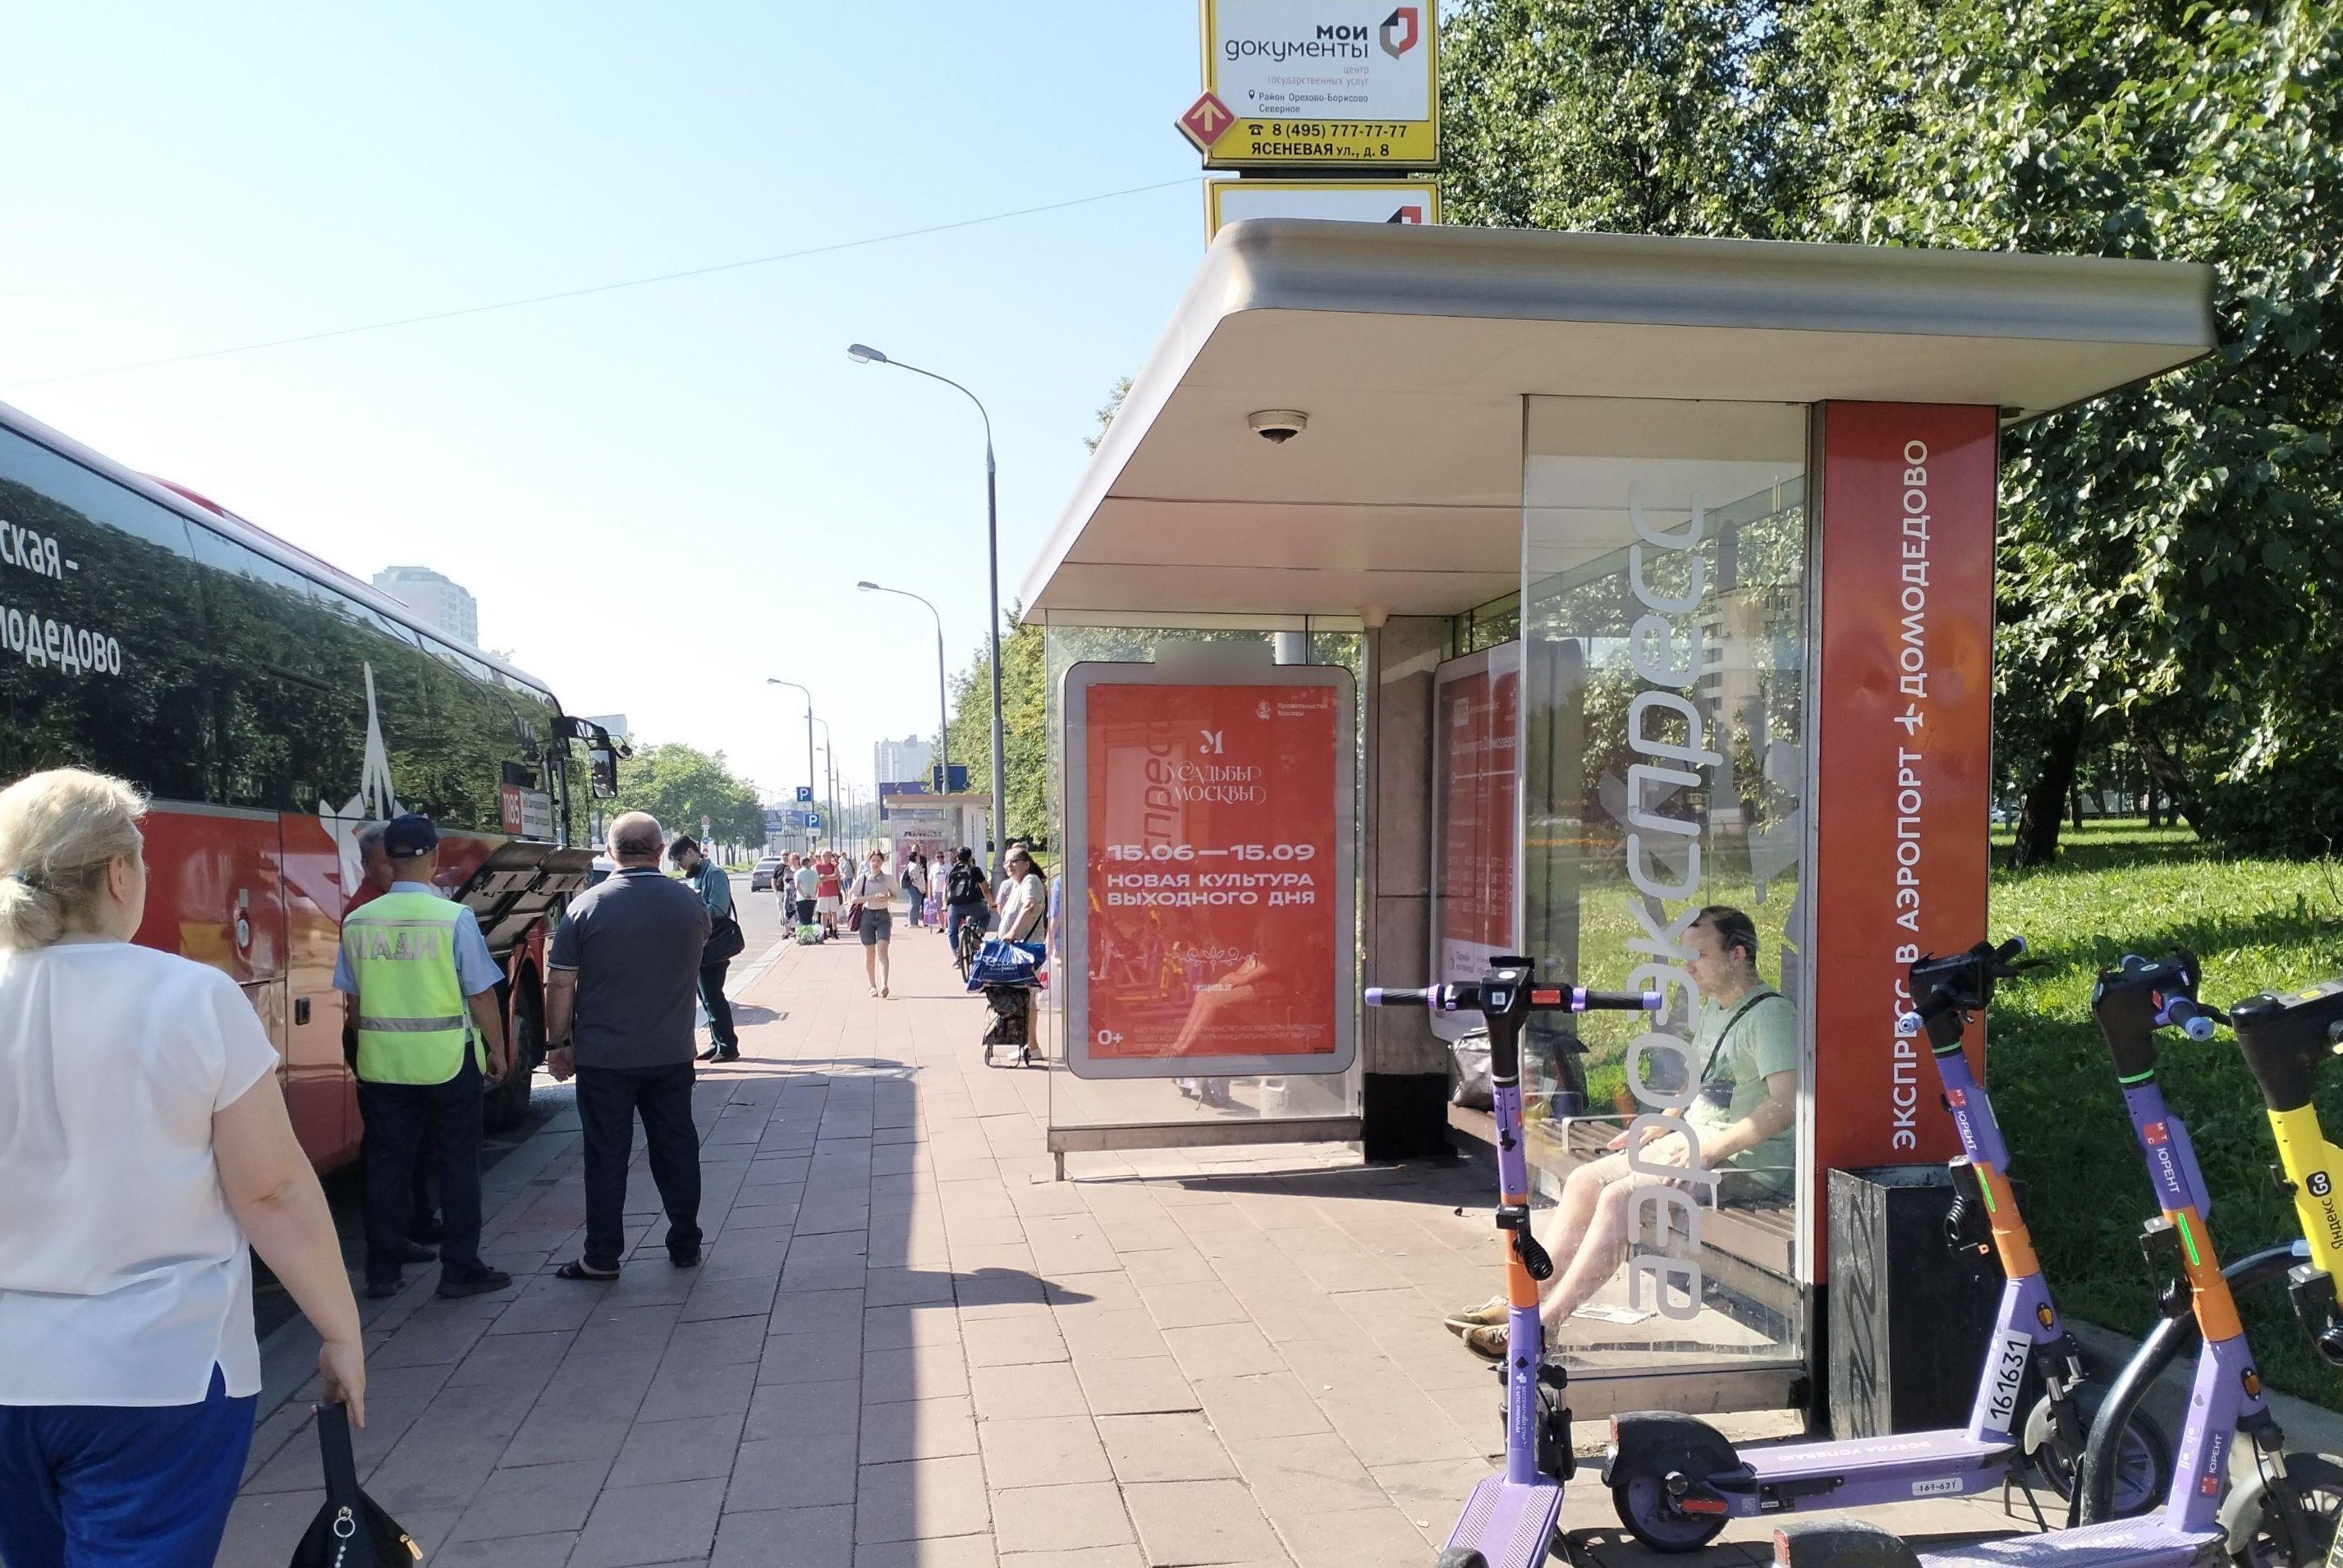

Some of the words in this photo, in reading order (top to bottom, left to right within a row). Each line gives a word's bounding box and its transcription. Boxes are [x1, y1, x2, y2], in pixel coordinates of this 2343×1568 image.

[1316, 25, 1369, 41] мои
[1225, 39, 1369, 62] документы
[1343, 66, 1369, 77] центр
[1268, 76, 1343, 87] государственных
[1346, 77, 1369, 88] услуг
[1259, 91, 1285, 102] Район
[1288, 92, 1369, 103] Орехово-Борисово
[1259, 103, 1300, 114] Северное
[1272, 123, 1282, 137] 8
[1286, 123, 1326, 139] (495)
[1330, 124, 1407, 138] 777-77-77
[1251, 142, 1333, 156] ЯСЕНЕВАЯ
[1337, 146, 1359, 158] ул.,
[1364, 146, 1375, 158] д.
[1380, 144, 1390, 156] 8
[1900, 439, 1931, 699] ДОМОДЕДОВО
[1162, 761, 1262, 786] УСАДЬБЫ
[1158, 785, 1267, 805] МОСКВЫ
[502, 791, 520, 825] 1185
[1896, 745, 1922, 933] АЭРОПОРТ
[1107, 873, 1190, 887] НОВАЯ
[1199, 873, 1314, 887] КУЛЬТУРА
[1107, 892, 1258, 907] ВЫХОДНОГО
[1268, 891, 1315, 906] ДНЯ
[1626, 479, 1723, 1322] аэроэкспресс
[1896, 943, 1919, 963] В
[1097, 1030, 1124, 1045] 0+
[1957, 1110, 1978, 1151] ЮРЕНТ
[2157, 1148, 2180, 1194] ЮРЕНТ
[2313, 1173, 2329, 1194] Go
[2322, 1197, 2343, 1250] Яндекс
[1990, 1340, 2028, 1419] 161631
[1777, 1449, 1863, 1461] УСПЕВАЮ
[1864, 1441, 1932, 1453] ВСЕГДА
[2208, 1433, 2222, 1474] ЮРЕНТ
[1920, 1482, 1956, 1492] 161-631
